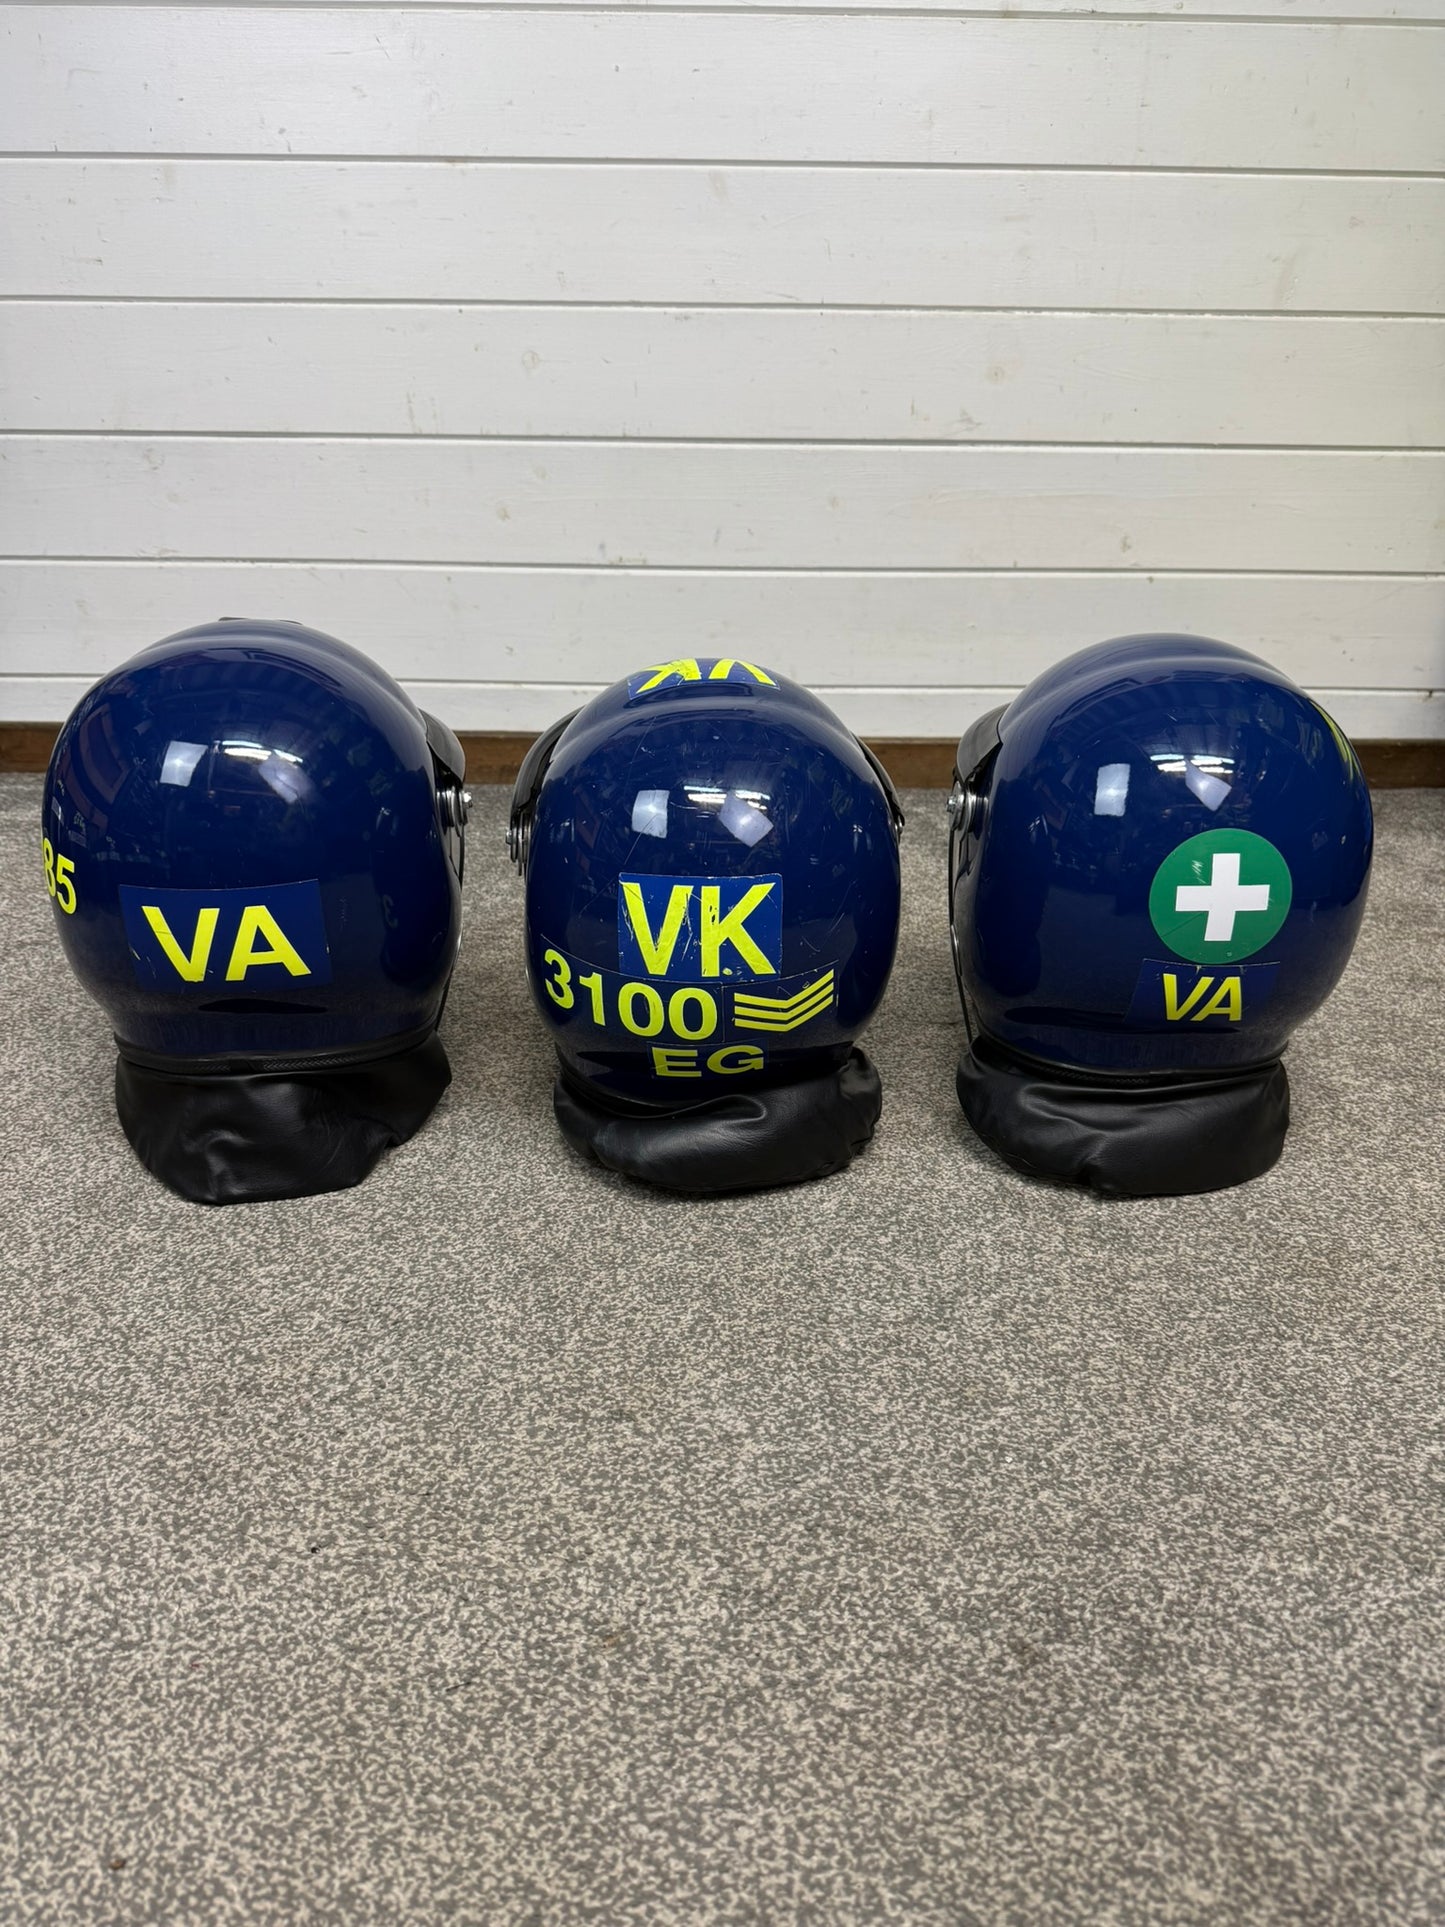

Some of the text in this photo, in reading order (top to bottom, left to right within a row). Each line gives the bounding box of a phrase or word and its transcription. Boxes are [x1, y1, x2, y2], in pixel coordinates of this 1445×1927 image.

[141, 905, 311, 982] VA
[622, 882, 777, 978] VK
[544, 949, 718, 1040] 3100
[1162, 973, 1242, 1021] VA
[651, 1045, 764, 1077] EG
